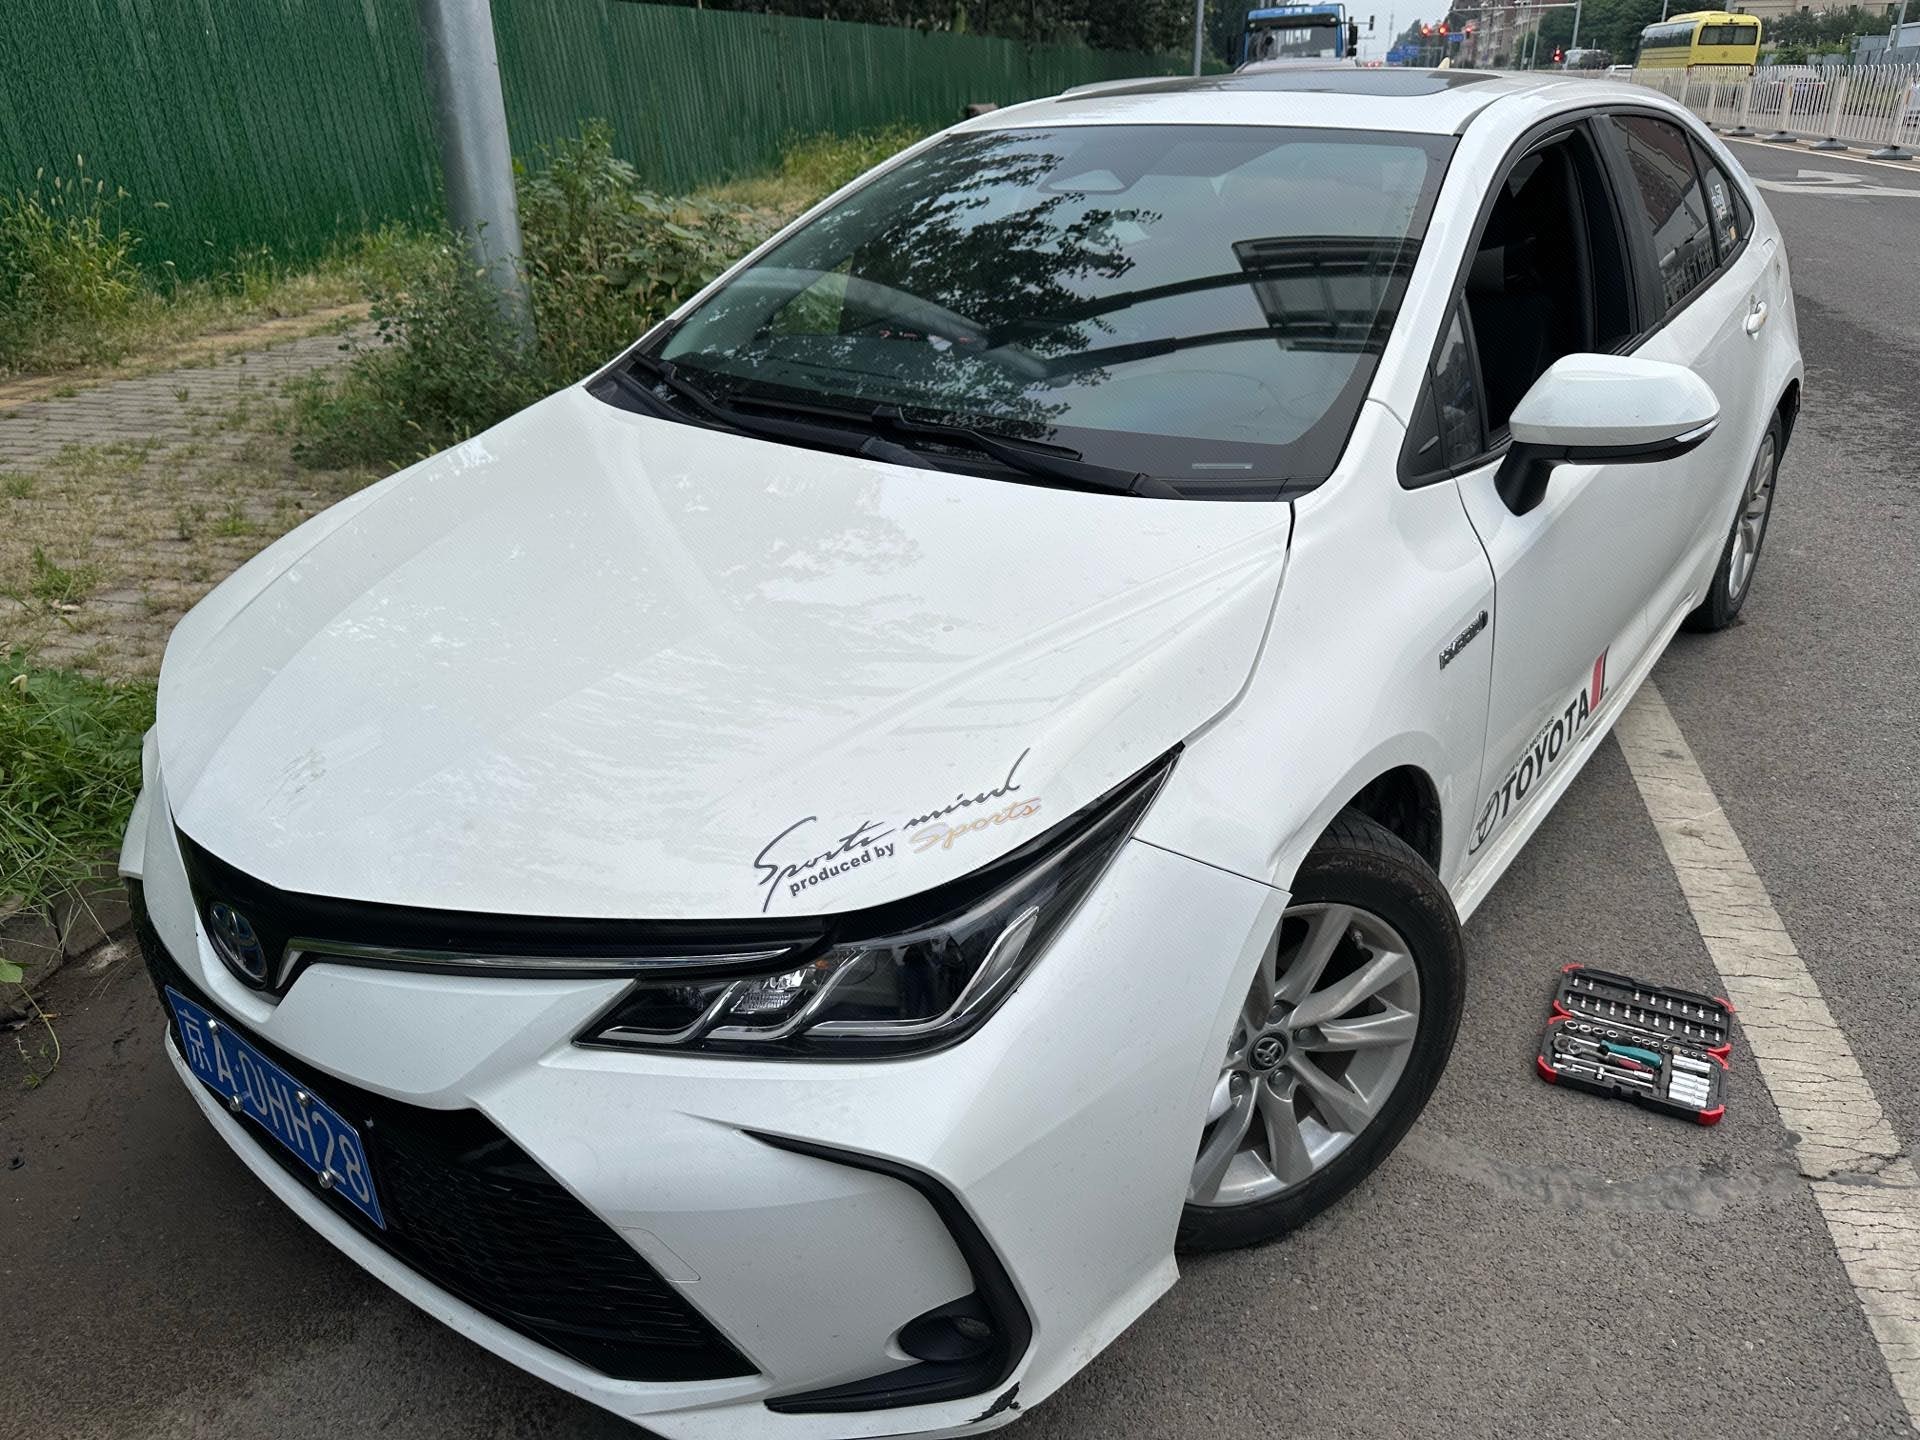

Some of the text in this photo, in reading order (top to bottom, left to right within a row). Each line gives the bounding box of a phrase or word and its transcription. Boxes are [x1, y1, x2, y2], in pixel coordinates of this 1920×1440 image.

[1502, 688, 1590, 820] TOYOTA
[909, 796, 1041, 854] Sports
[789, 842, 896, 896] produced by
